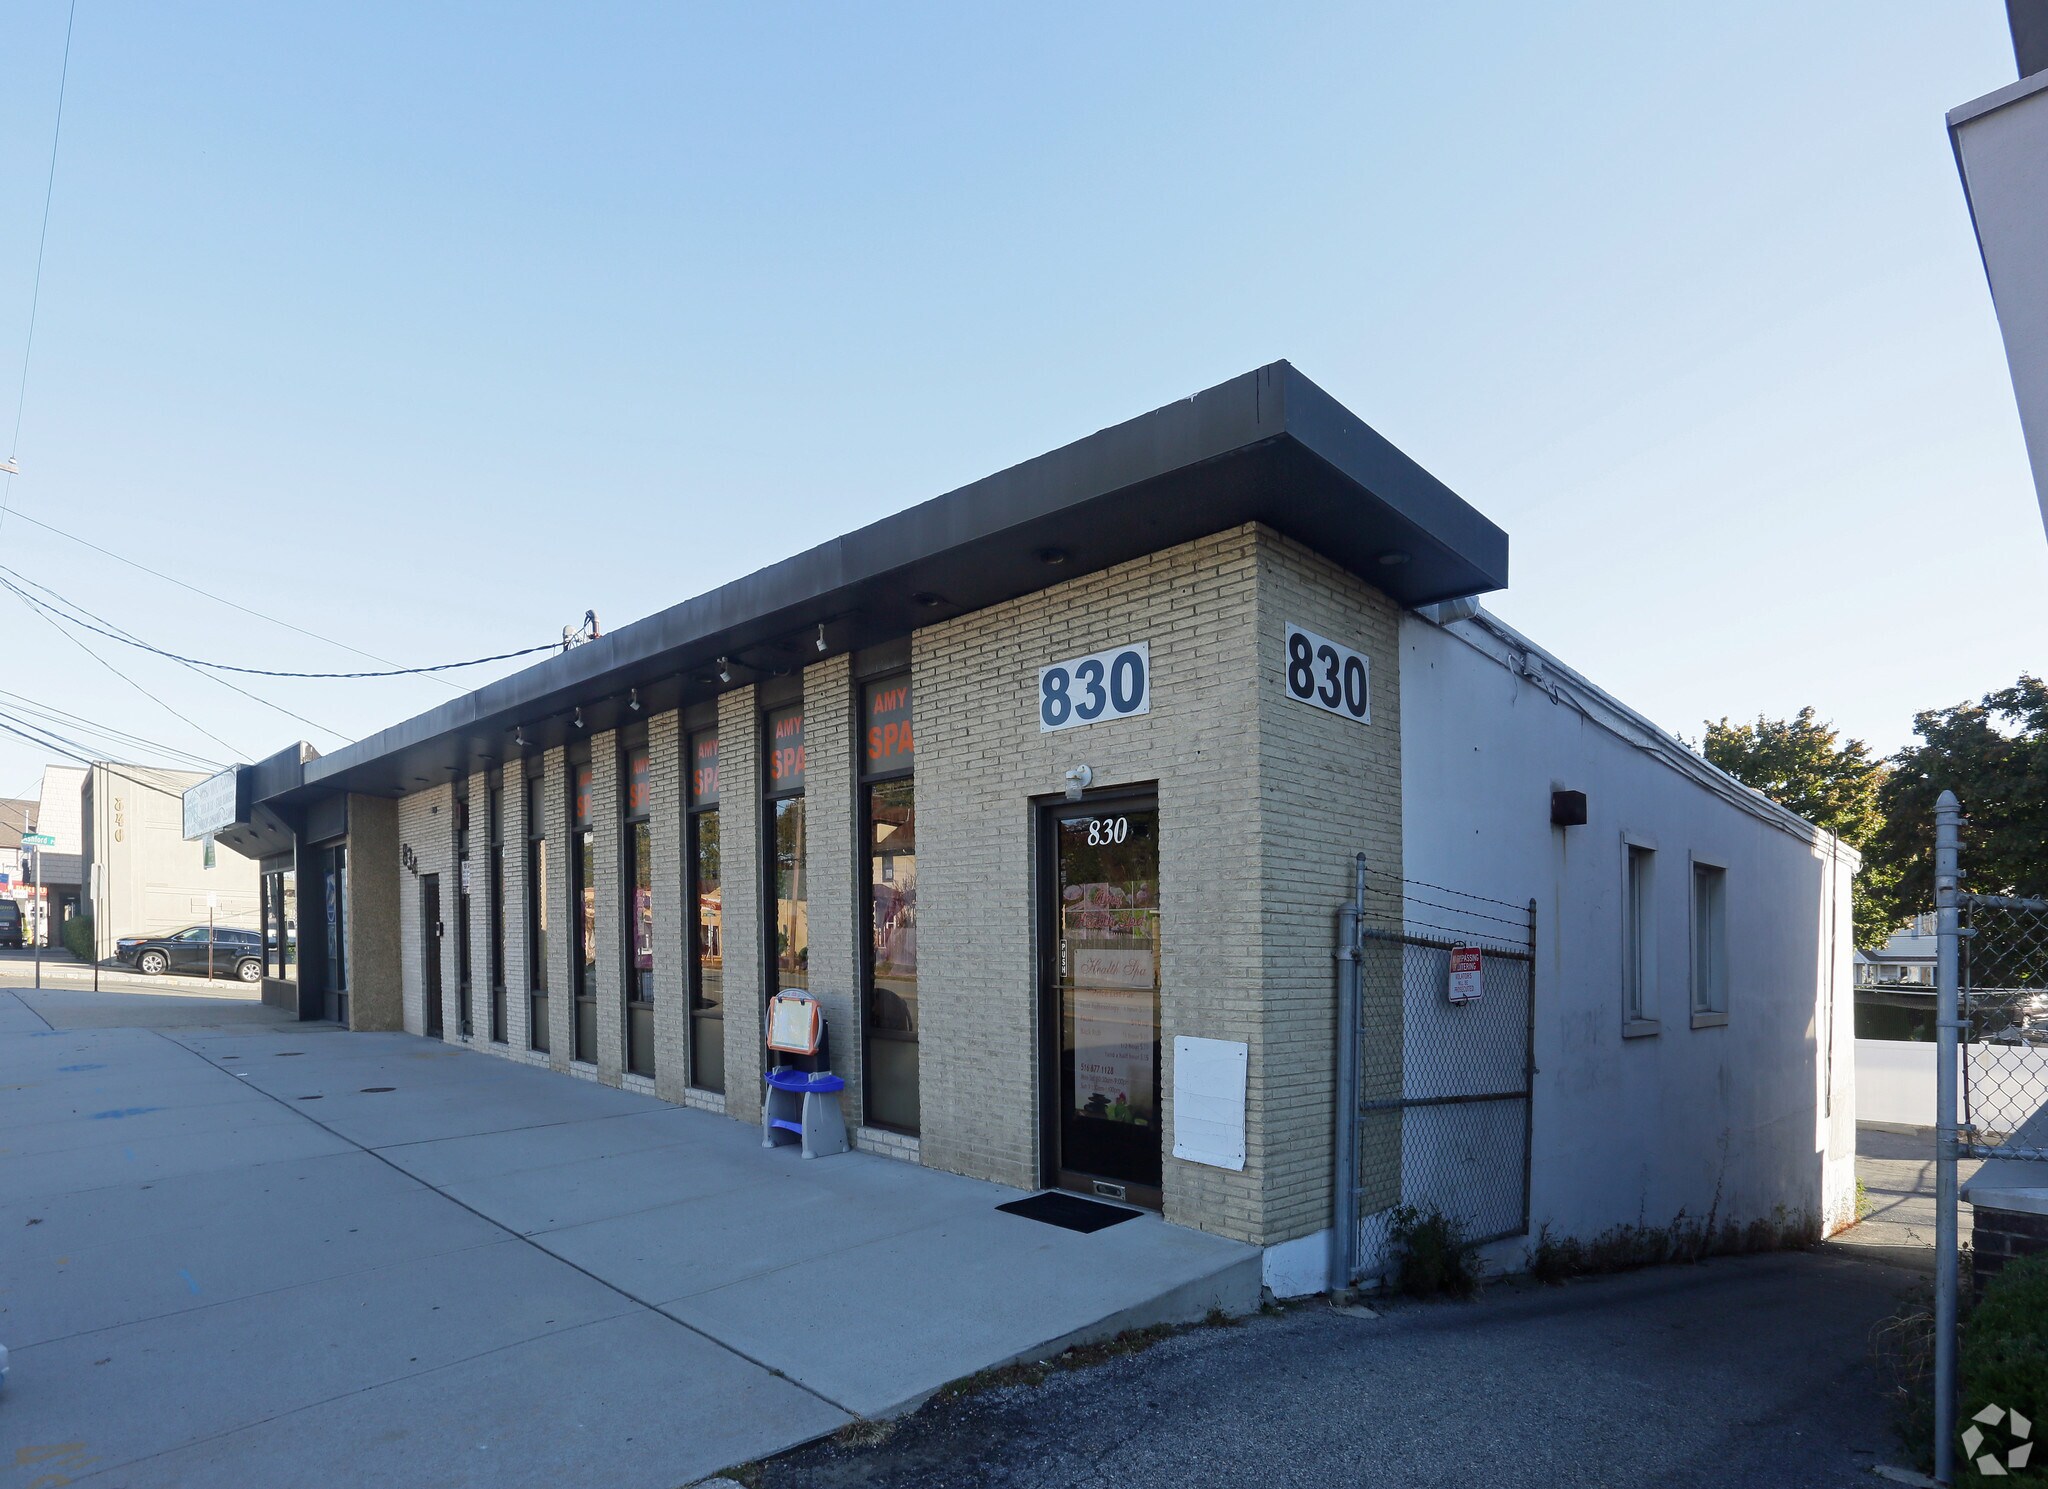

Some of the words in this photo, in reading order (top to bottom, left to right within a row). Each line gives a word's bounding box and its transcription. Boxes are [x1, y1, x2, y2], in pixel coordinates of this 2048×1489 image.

[1041, 650, 1145, 727] 830
[1289, 632, 1367, 718] 830
[873, 686, 908, 715] AMY
[775, 714, 804, 739] AMY
[868, 719, 914, 760] SPA
[771, 744, 805, 781] SPA
[1087, 817, 1129, 847] 830
[402, 843, 419, 880] 834
[1119, 911, 1146, 930] Spa
[1080, 958, 1120, 976] Health
[1123, 958, 1147, 981] Spa
[1101, 1065, 1114, 1075] 1128
